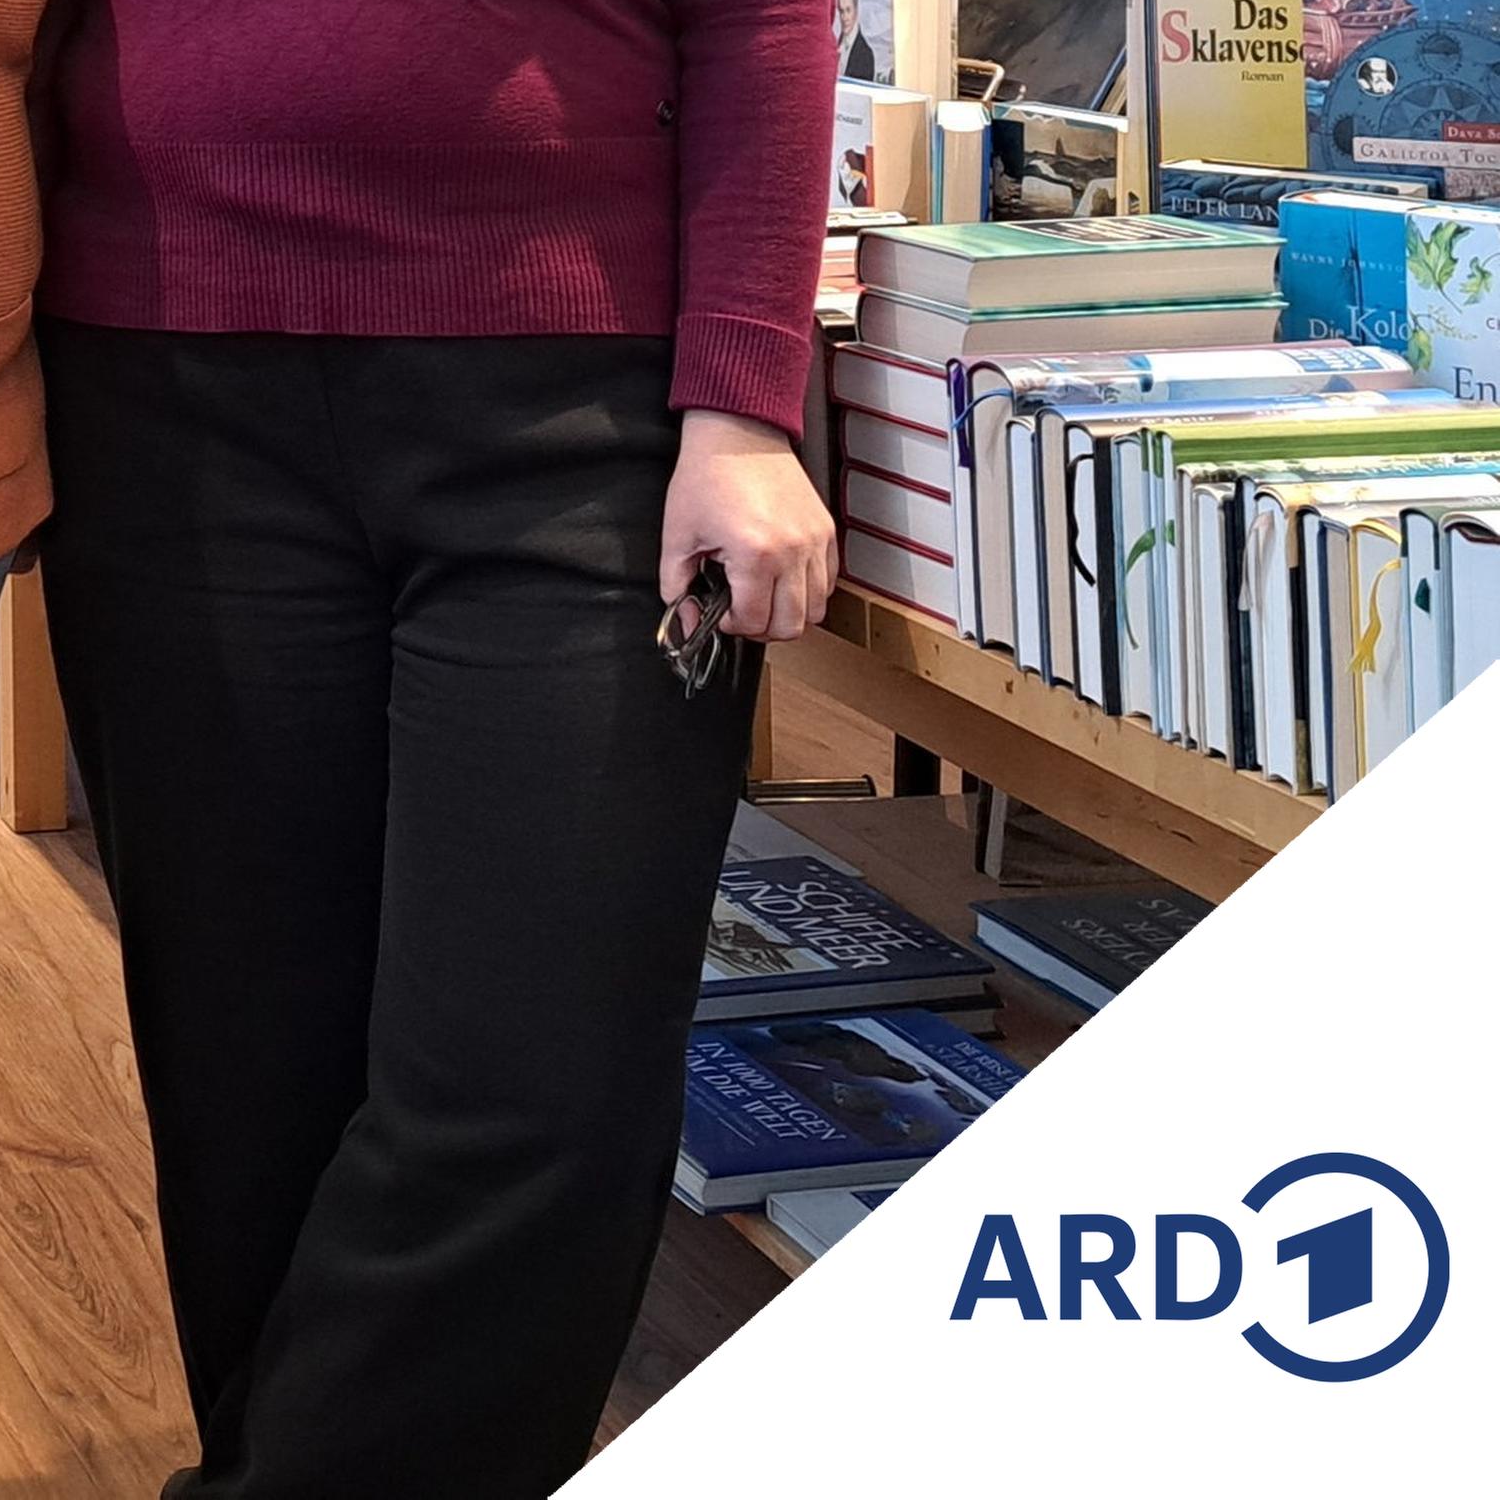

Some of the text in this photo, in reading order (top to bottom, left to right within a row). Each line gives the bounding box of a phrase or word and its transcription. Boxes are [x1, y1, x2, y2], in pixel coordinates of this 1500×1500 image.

[1241, 71, 1285, 83] Roman
[1171, 195, 1231, 218] PETER
[1291, 251, 1335, 266] WAYNE
[1308, 317, 1345, 340] Die
[719, 870, 890, 970] UND MEER
[778, 881, 922, 951] SCHIFFE
[696, 1041, 847, 1143] IN 1000 TAGEN
[698, 1071, 751, 1101] DIE
[741, 1098, 809, 1140] WELT
